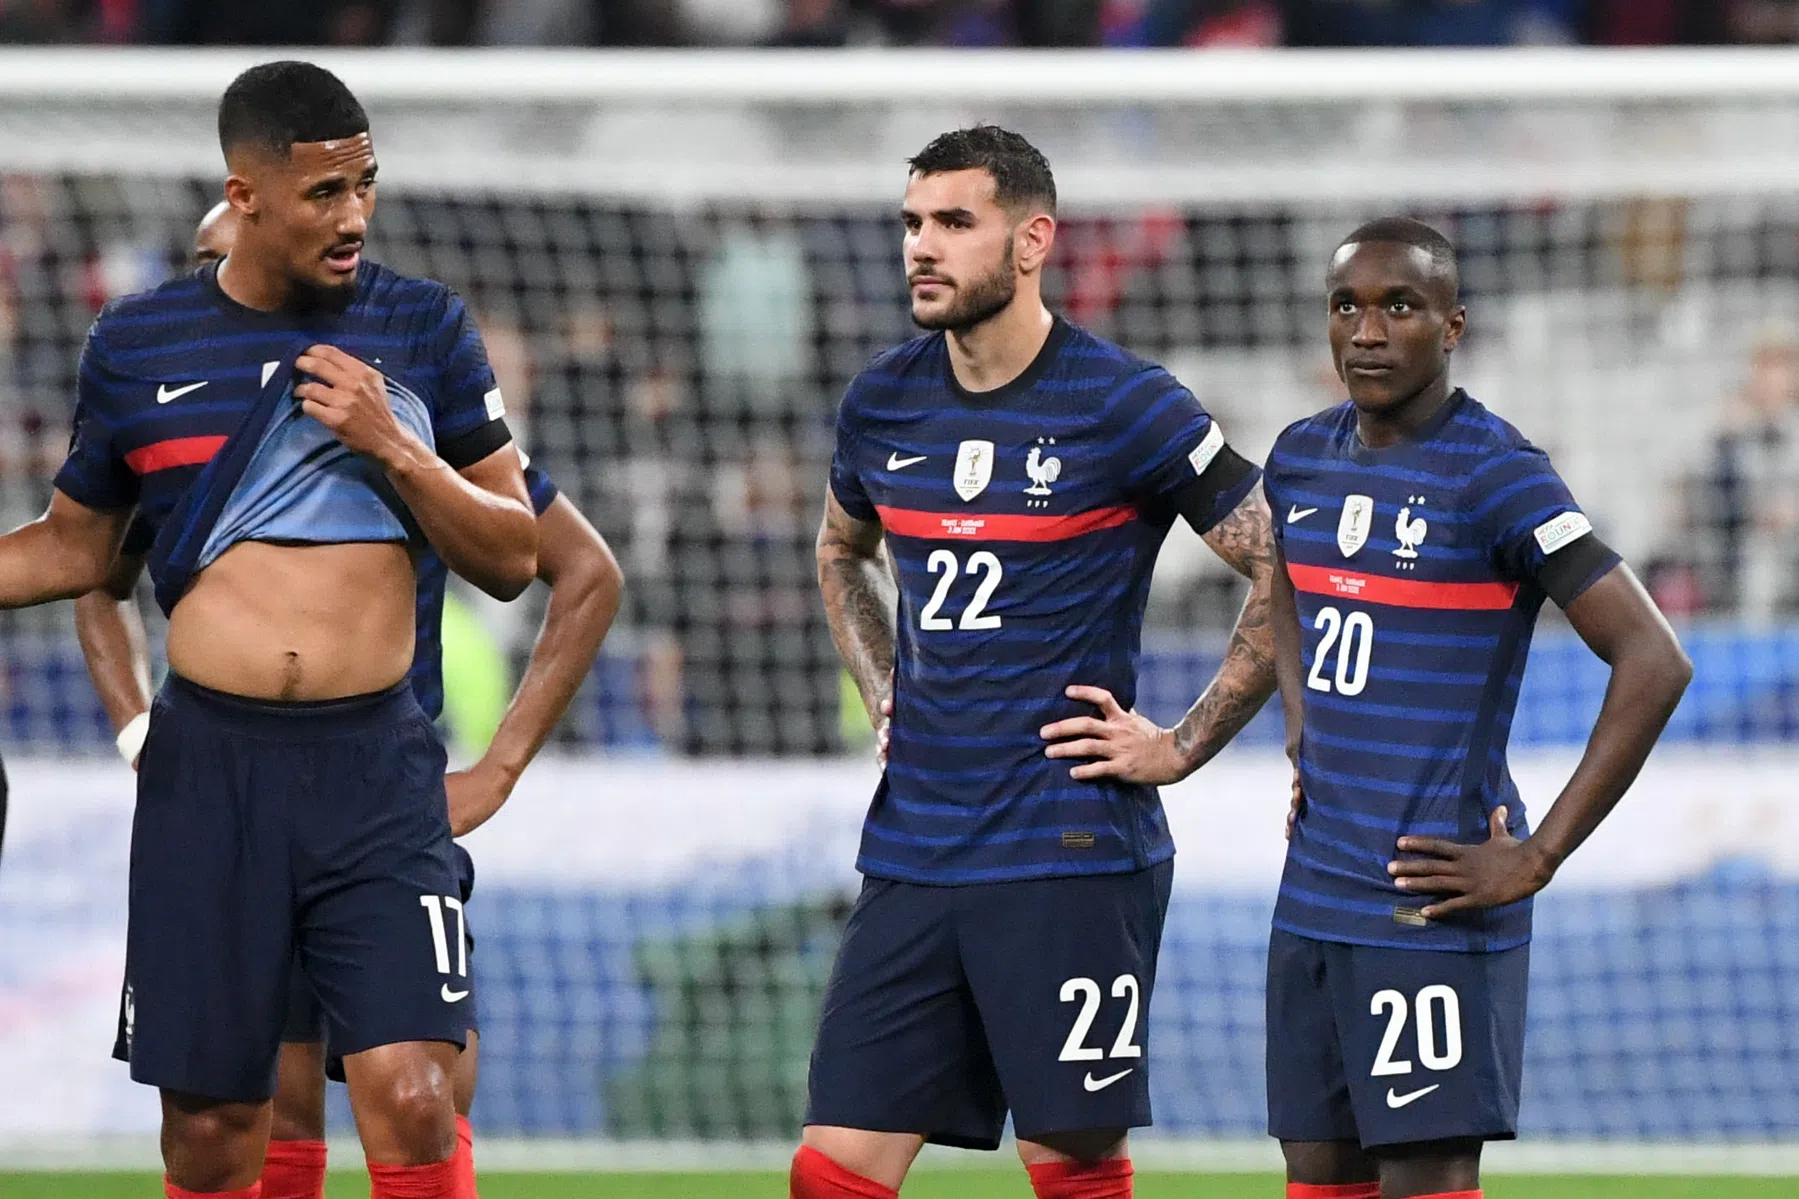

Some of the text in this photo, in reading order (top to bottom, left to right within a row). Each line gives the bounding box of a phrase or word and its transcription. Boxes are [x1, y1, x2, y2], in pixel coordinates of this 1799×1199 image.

[921, 549, 1003, 631] 22
[1307, 606, 1374, 696] 20
[420, 894, 468, 977] 17
[1058, 974, 1141, 1061] 22
[1370, 984, 1462, 1076] 20
